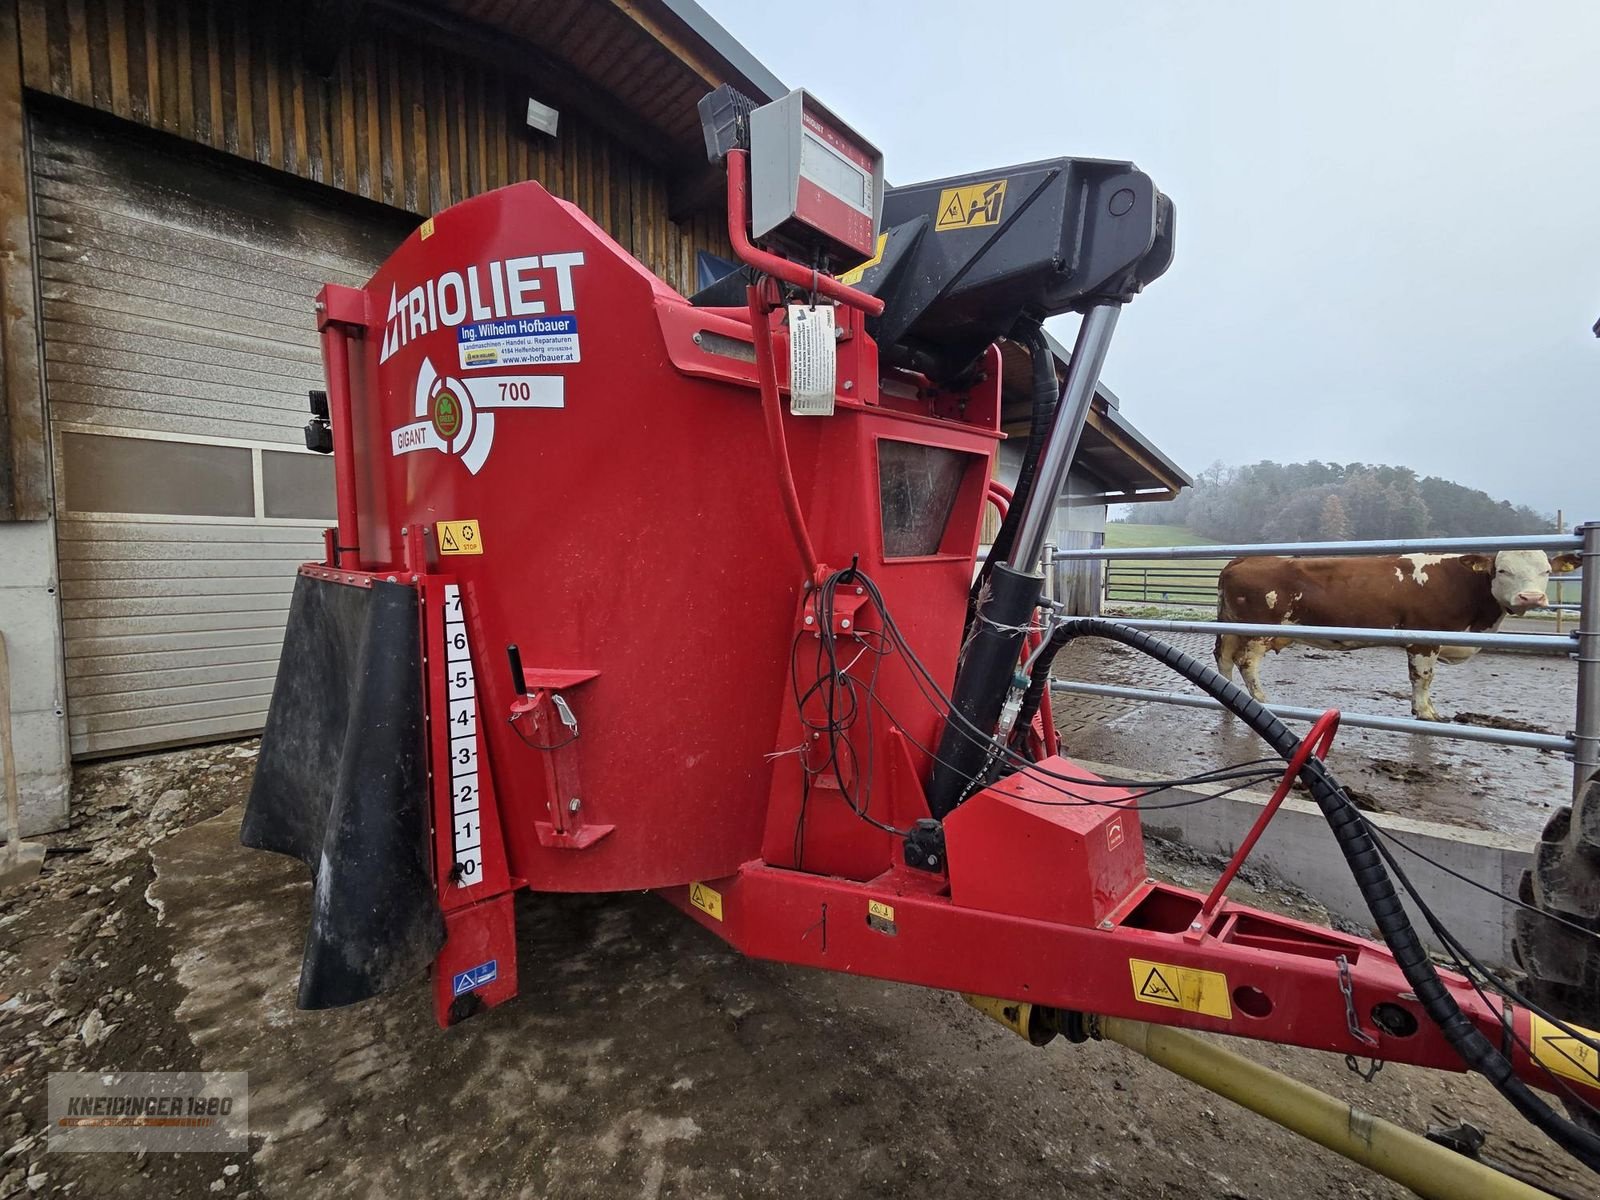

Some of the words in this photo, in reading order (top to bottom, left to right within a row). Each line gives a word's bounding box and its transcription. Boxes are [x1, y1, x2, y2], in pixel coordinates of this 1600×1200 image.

[397, 252, 585, 346] TRIOLIET
[462, 327, 478, 340] Ing.
[478, 322, 517, 337] Wilhelm
[519, 319, 570, 334] Hofbauer
[463, 342, 501, 350] Landmaschinen
[502, 353, 574, 364] www.w-hofbauer.at
[498, 382, 530, 401] 700
[397, 427, 427, 449] GIGANT
[452, 594, 462, 610] 7
[454, 633, 466, 649] 6
[456, 672, 467, 688] 5
[457, 710, 469, 726] 4
[458, 748, 470, 764] 3
[460, 786, 472, 802] 2
[463, 822, 470, 838] 1
[464, 859, 475, 875] 0
